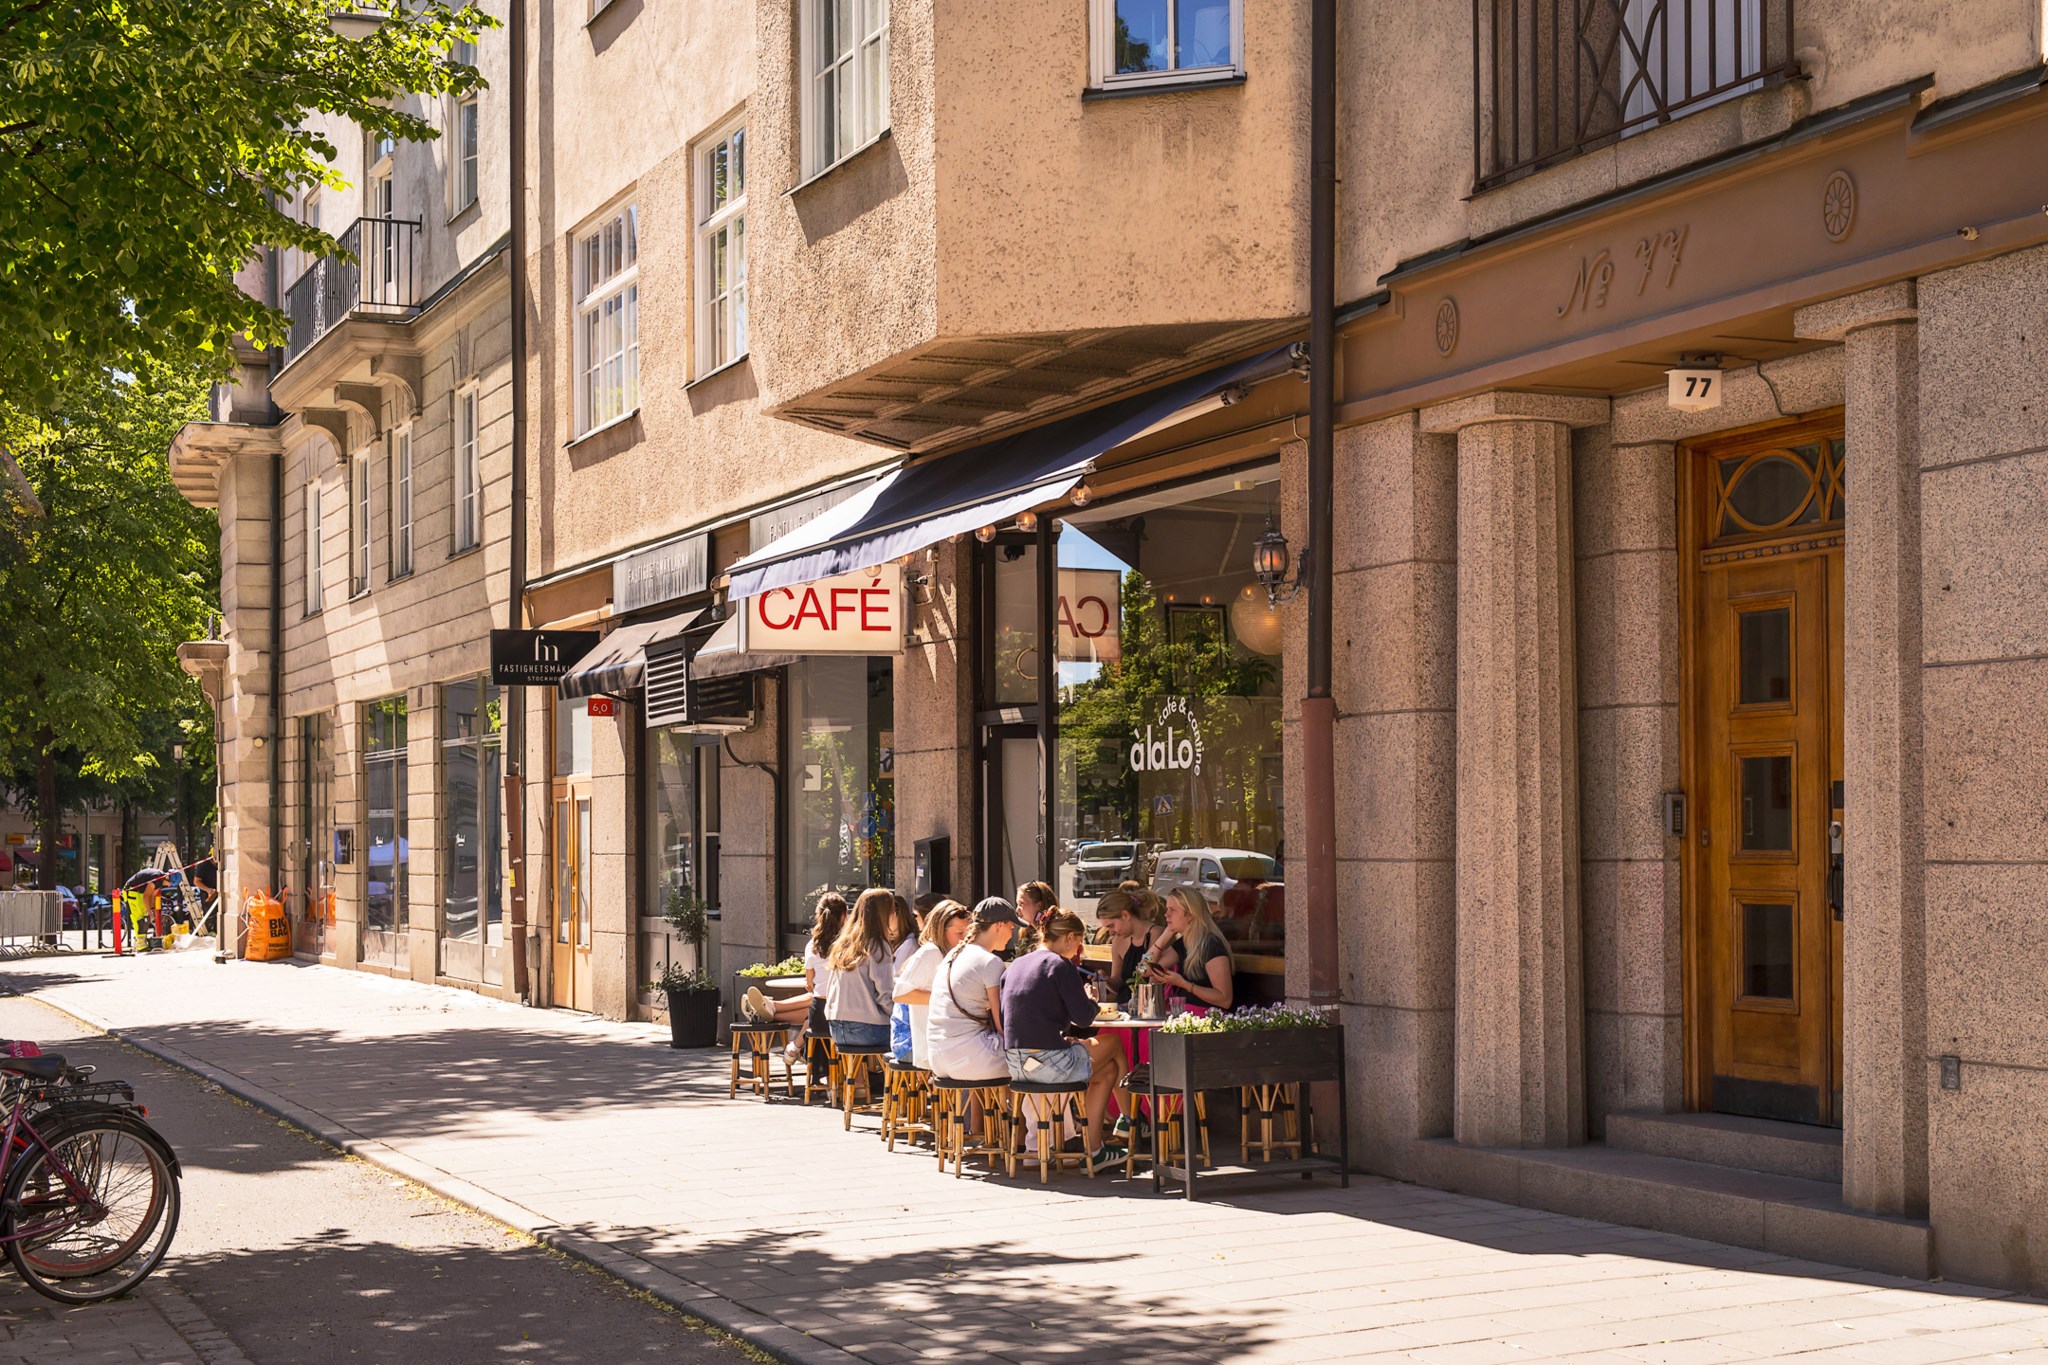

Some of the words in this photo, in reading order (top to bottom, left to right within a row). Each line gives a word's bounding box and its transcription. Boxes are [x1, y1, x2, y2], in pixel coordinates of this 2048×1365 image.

[1635, 224, 1689, 296] 77
[1685, 377, 1712, 398] 77
[759, 578, 892, 631] CAFÉ
[1159, 696, 1177, 726] café
[1178, 696, 1187, 715] &
[269, 917, 286, 929] BIG
[270, 928, 288, 937] BAG
